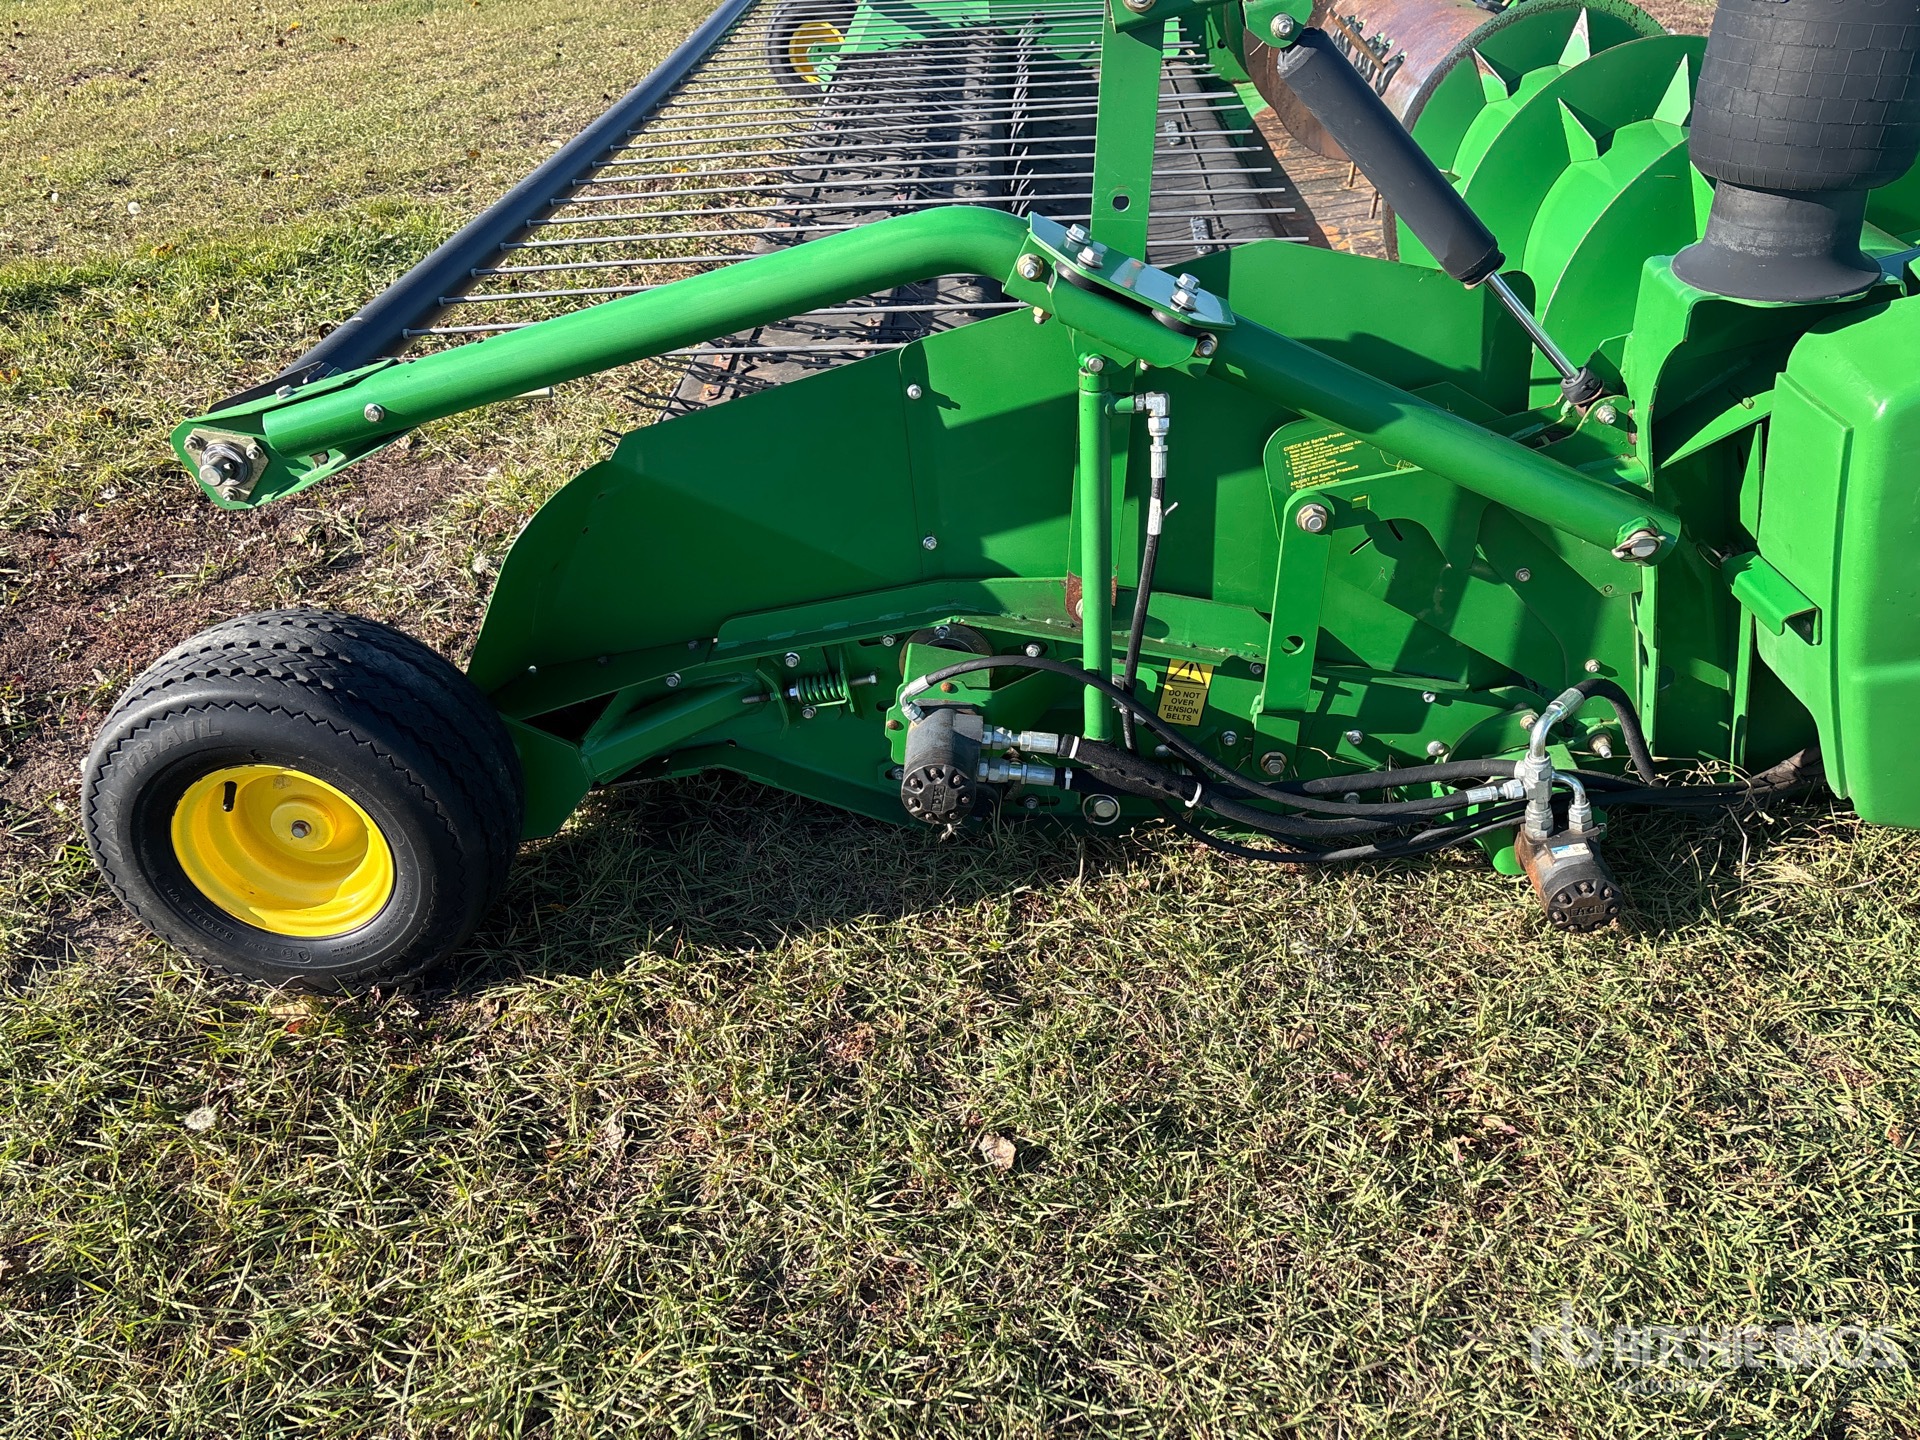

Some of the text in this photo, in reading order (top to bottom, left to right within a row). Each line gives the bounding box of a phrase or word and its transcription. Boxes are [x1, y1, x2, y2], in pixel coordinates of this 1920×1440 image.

[1283, 443, 1302, 451] CHECK
[1290, 477, 1309, 486] ADJUST
[1336, 465, 1358, 473] Pressure
[1171, 697, 1195, 706] OVER
[1163, 704, 1199, 714] TENSION
[1165, 713, 1192, 721] BELTS
[119, 718, 224, 777] TRAIL
